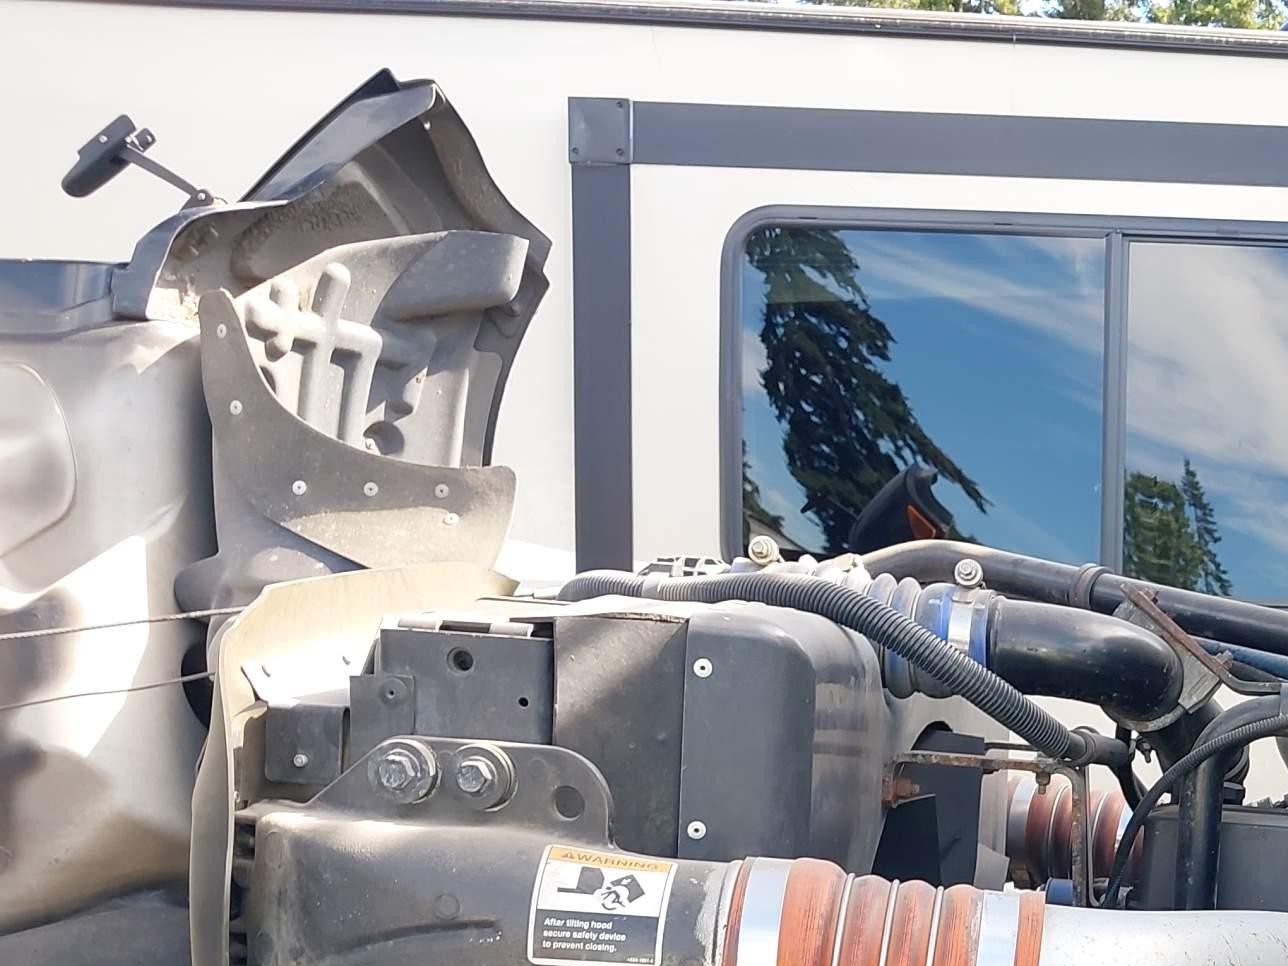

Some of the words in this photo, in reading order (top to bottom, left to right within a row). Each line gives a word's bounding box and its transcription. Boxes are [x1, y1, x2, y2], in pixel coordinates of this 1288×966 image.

[575, 852, 659, 871] WARNING
[543, 917, 565, 927] After
[566, 918, 590, 929] tilting
[591, 920, 613, 929] hood
[543, 930, 571, 938] secure
[572, 930, 598, 940] safety
[599, 931, 627, 941] device
[542, 940, 552, 948] to
[552, 941, 584, 950] prevent
[585, 943, 617, 953] closing.
